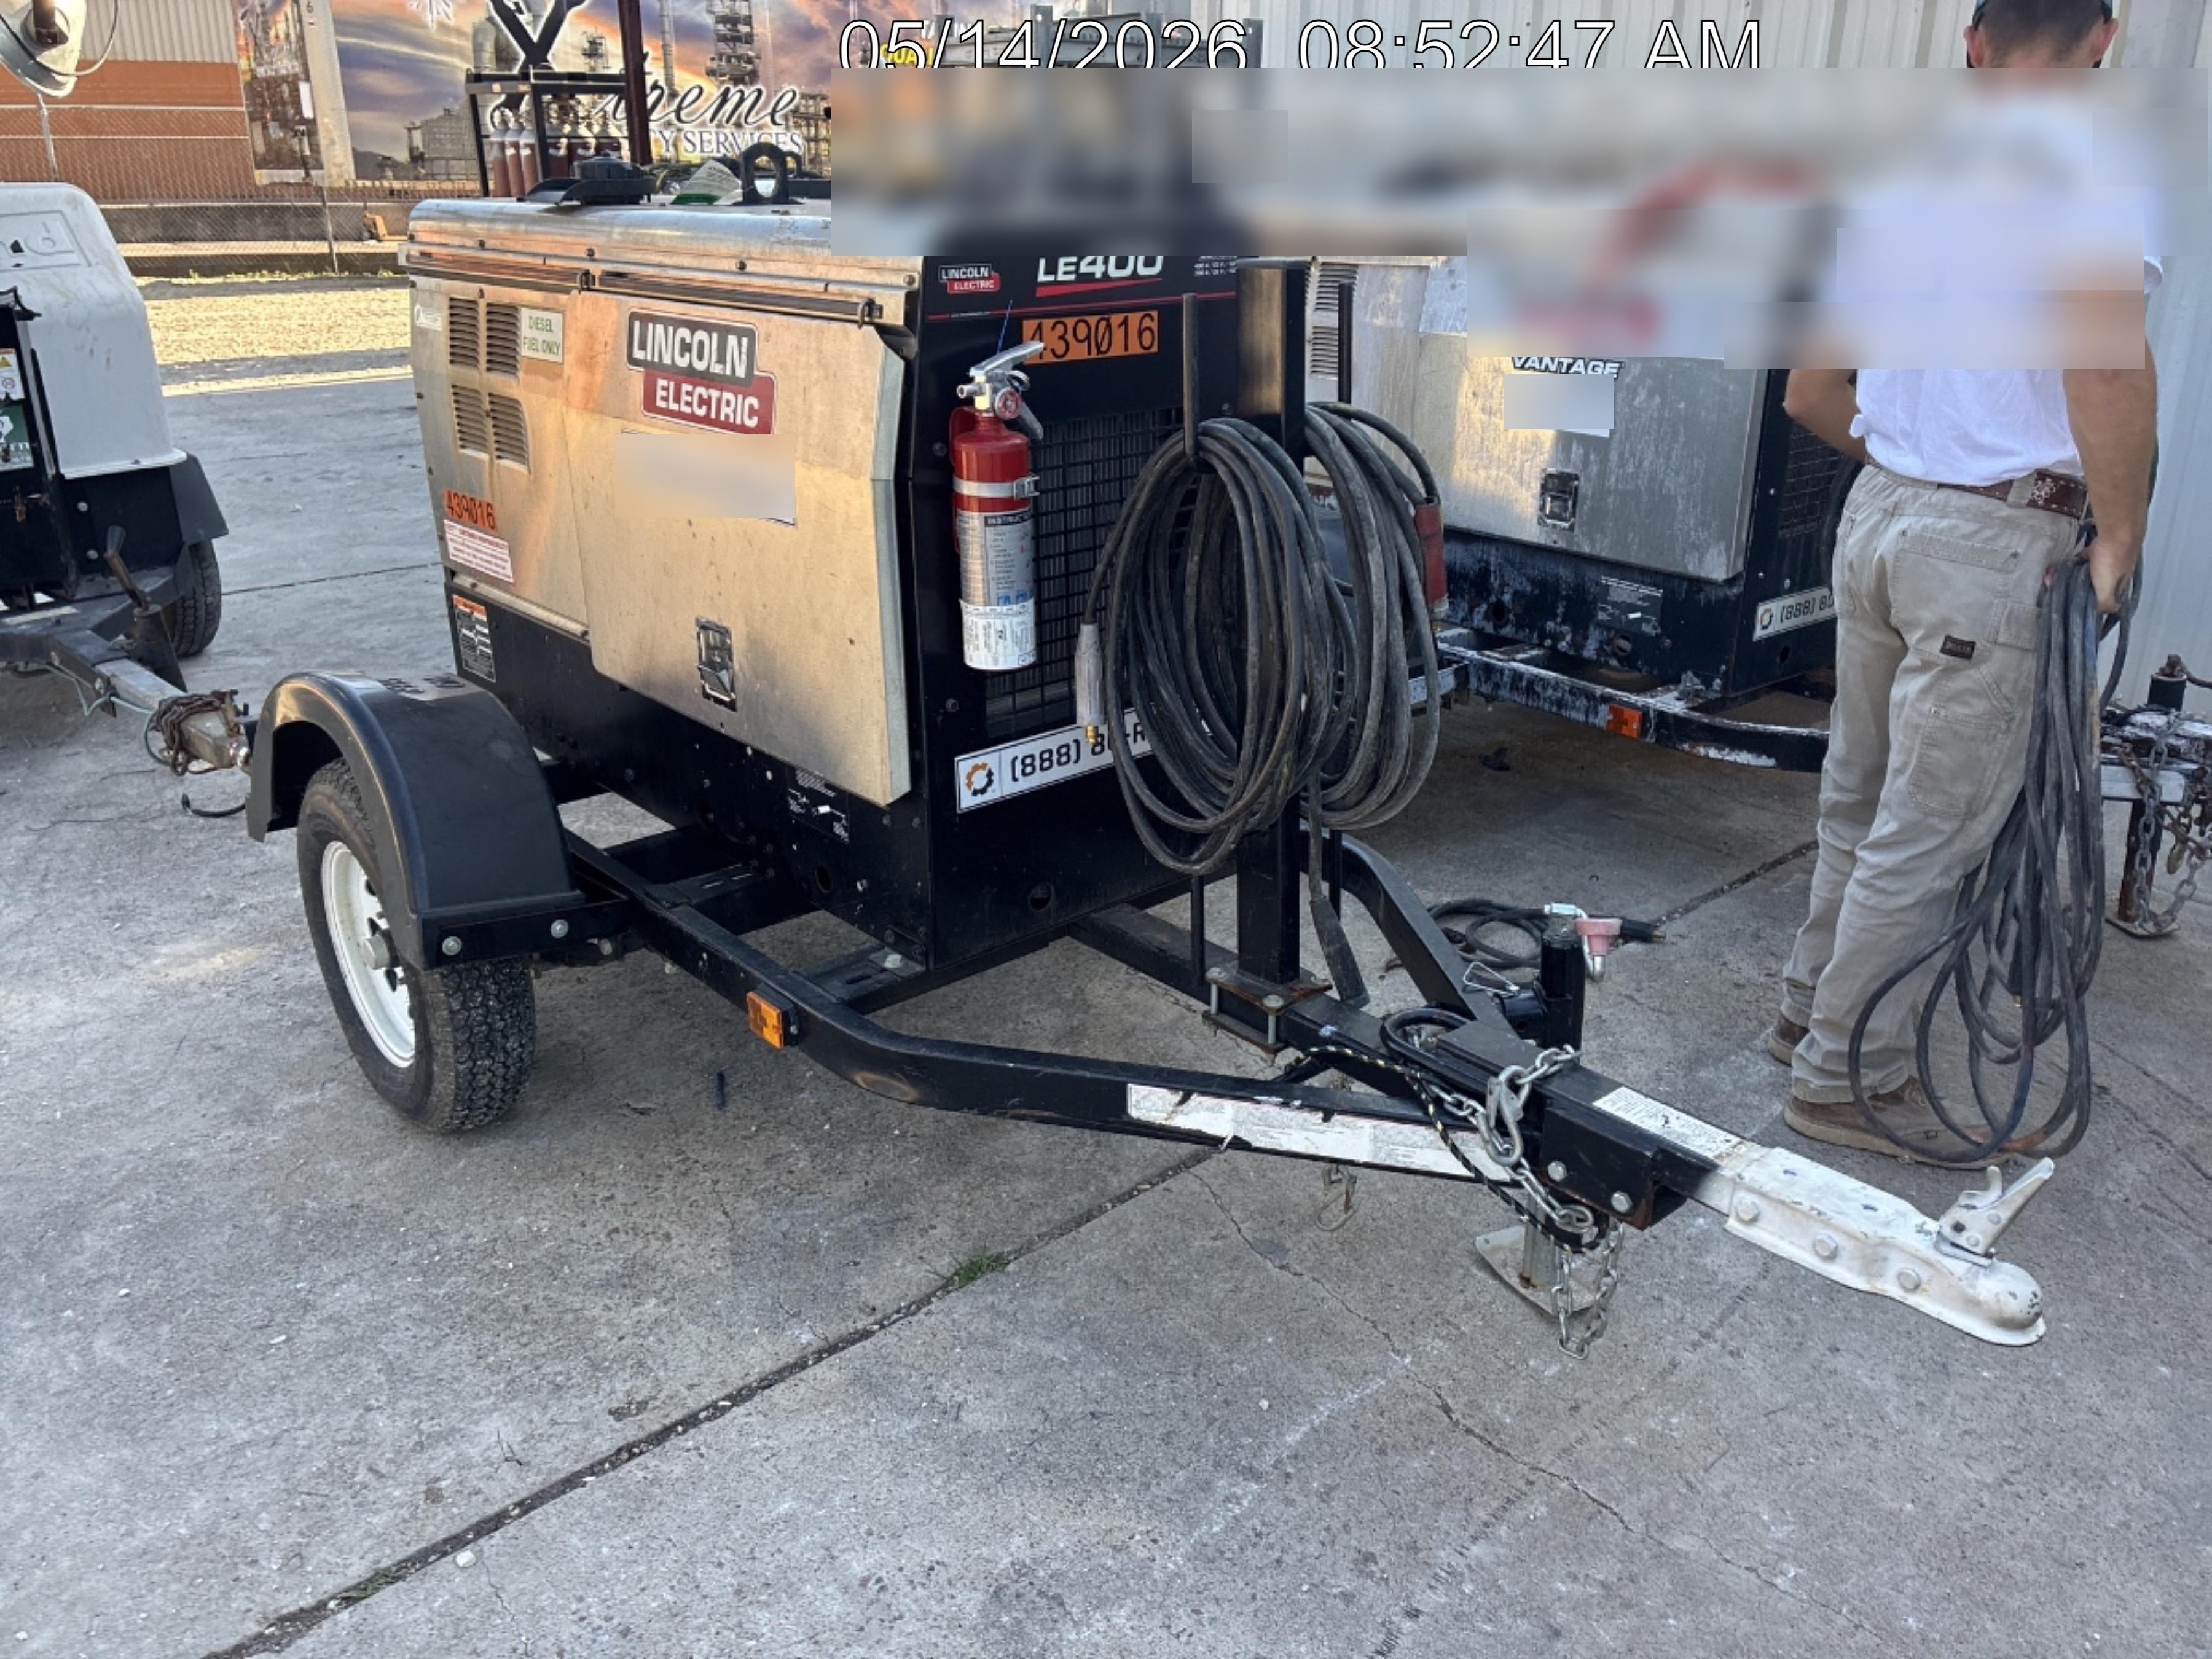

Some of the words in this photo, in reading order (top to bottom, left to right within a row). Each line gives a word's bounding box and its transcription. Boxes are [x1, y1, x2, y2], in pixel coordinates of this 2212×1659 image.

[941, 267, 989, 280] LINCOLN
[1037, 256, 1164, 283] LE400
[954, 280, 994, 291] ELECTRIC
[632, 320, 749, 379] LINCOLN
[1513, 357, 1621, 378] VANTAGE
[655, 377, 759, 428] ELECTRIC
[1780, 597, 1816, 624] (888)
[1010, 739, 1081, 782] (888)
